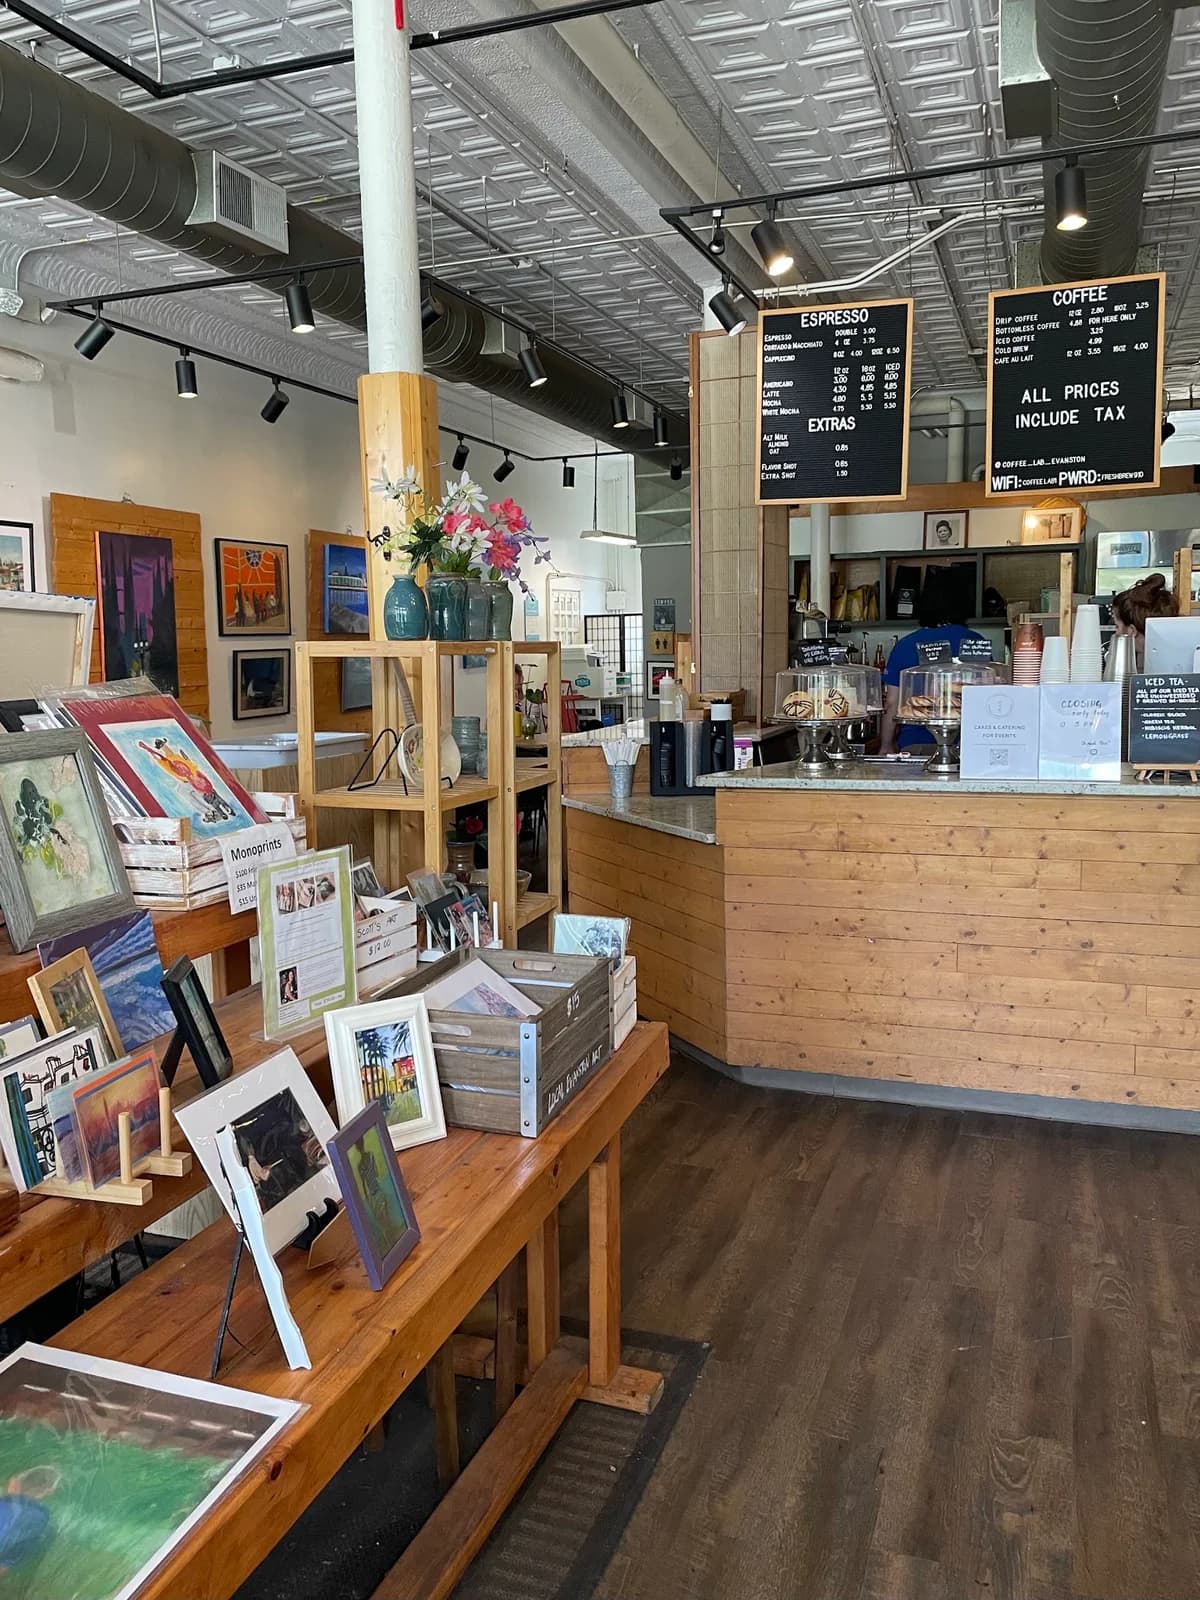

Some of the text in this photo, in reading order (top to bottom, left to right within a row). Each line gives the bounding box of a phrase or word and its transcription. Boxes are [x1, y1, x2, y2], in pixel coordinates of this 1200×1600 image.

[1053, 286, 1108, 306] COFFEE
[801, 309, 869, 327] ESPRESSO
[1015, 314, 1038, 322] COFFEE
[1089, 317, 1100, 325] FOR
[1102, 315, 1118, 323] HERE
[1120, 313, 1136, 321] ONLY
[835, 328, 858, 336] DOUBLE
[996, 322, 1060, 334] BOTTOMLESS COFFEE
[1090, 327, 1103, 335] 3.25
[764, 334, 792, 342] ESPRESSO
[1012, 335, 1035, 343] COFFEE
[1088, 337, 1102, 345] 4.99
[793, 341, 823, 349] MACCHIATO
[1134, 342, 1148, 350] 4.00
[763, 380, 794, 388] AMERICANO
[1021, 381, 1120, 404] ALL PRICES
[780, 408, 800, 416] MOCHA
[1015, 405, 1126, 429] INCLUDE TAX
[808, 416, 856, 432] EXTRAS
[1059, 469, 1101, 487] PWRD:
[1145, 678, 1165, 686] ICED
[1061, 700, 1102, 708] CLOSING
[231, 839, 281, 861] Monoprints
[235, 869, 247, 878] $100
[239, 897, 248, 906] $15
[368, 940, 391, 956] $12.00
